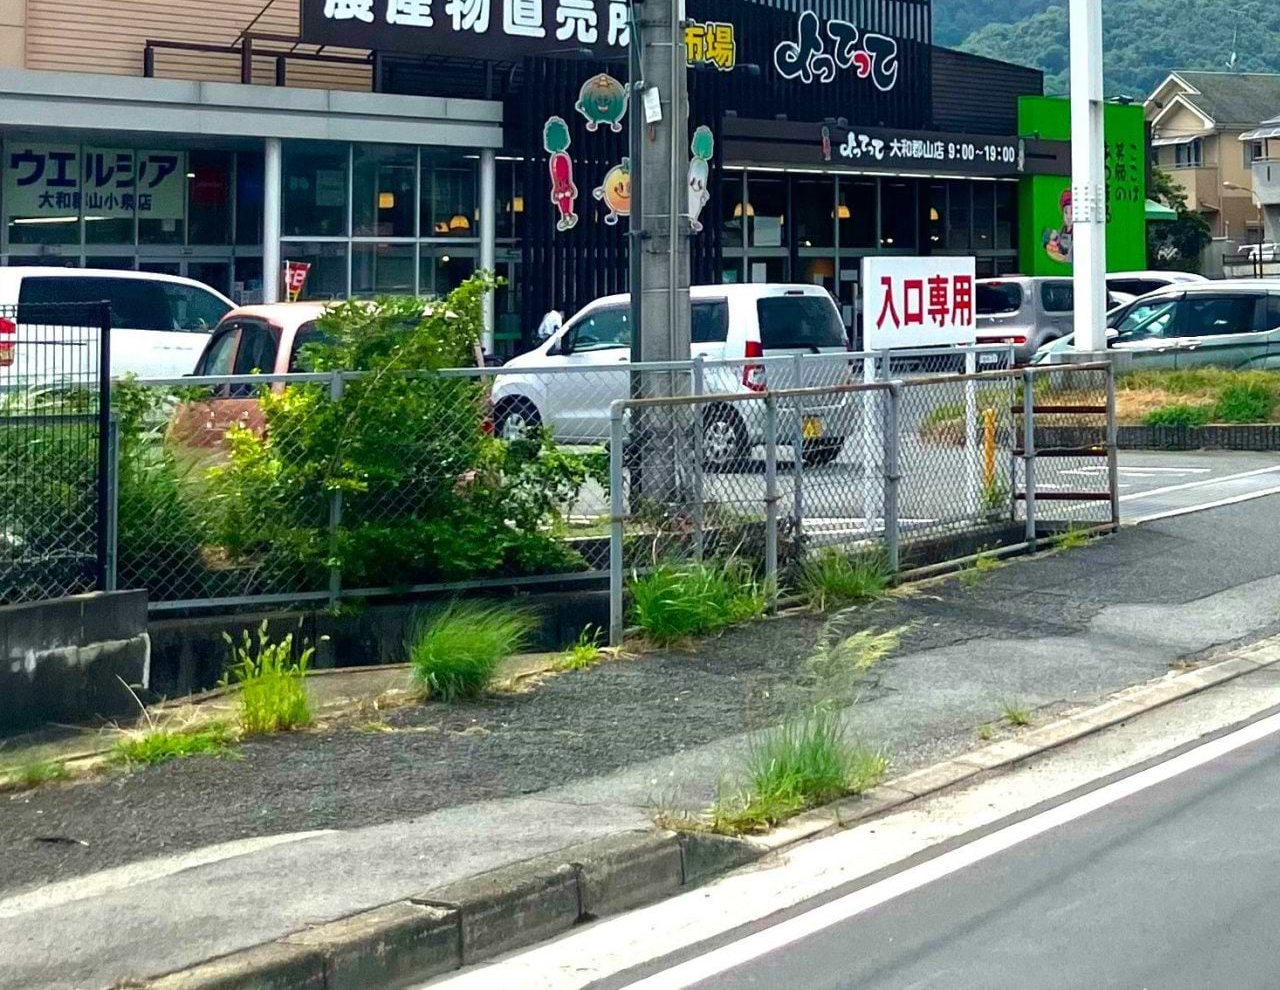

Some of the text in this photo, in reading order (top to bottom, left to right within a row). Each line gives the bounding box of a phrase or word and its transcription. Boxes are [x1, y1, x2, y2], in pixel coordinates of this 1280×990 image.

[774, 10, 898, 91] よってって
[11, 149, 179, 188] ウエルシア
[889, 138, 945, 159] 大和郡山店
[876, 274, 973, 329] 入口専用
